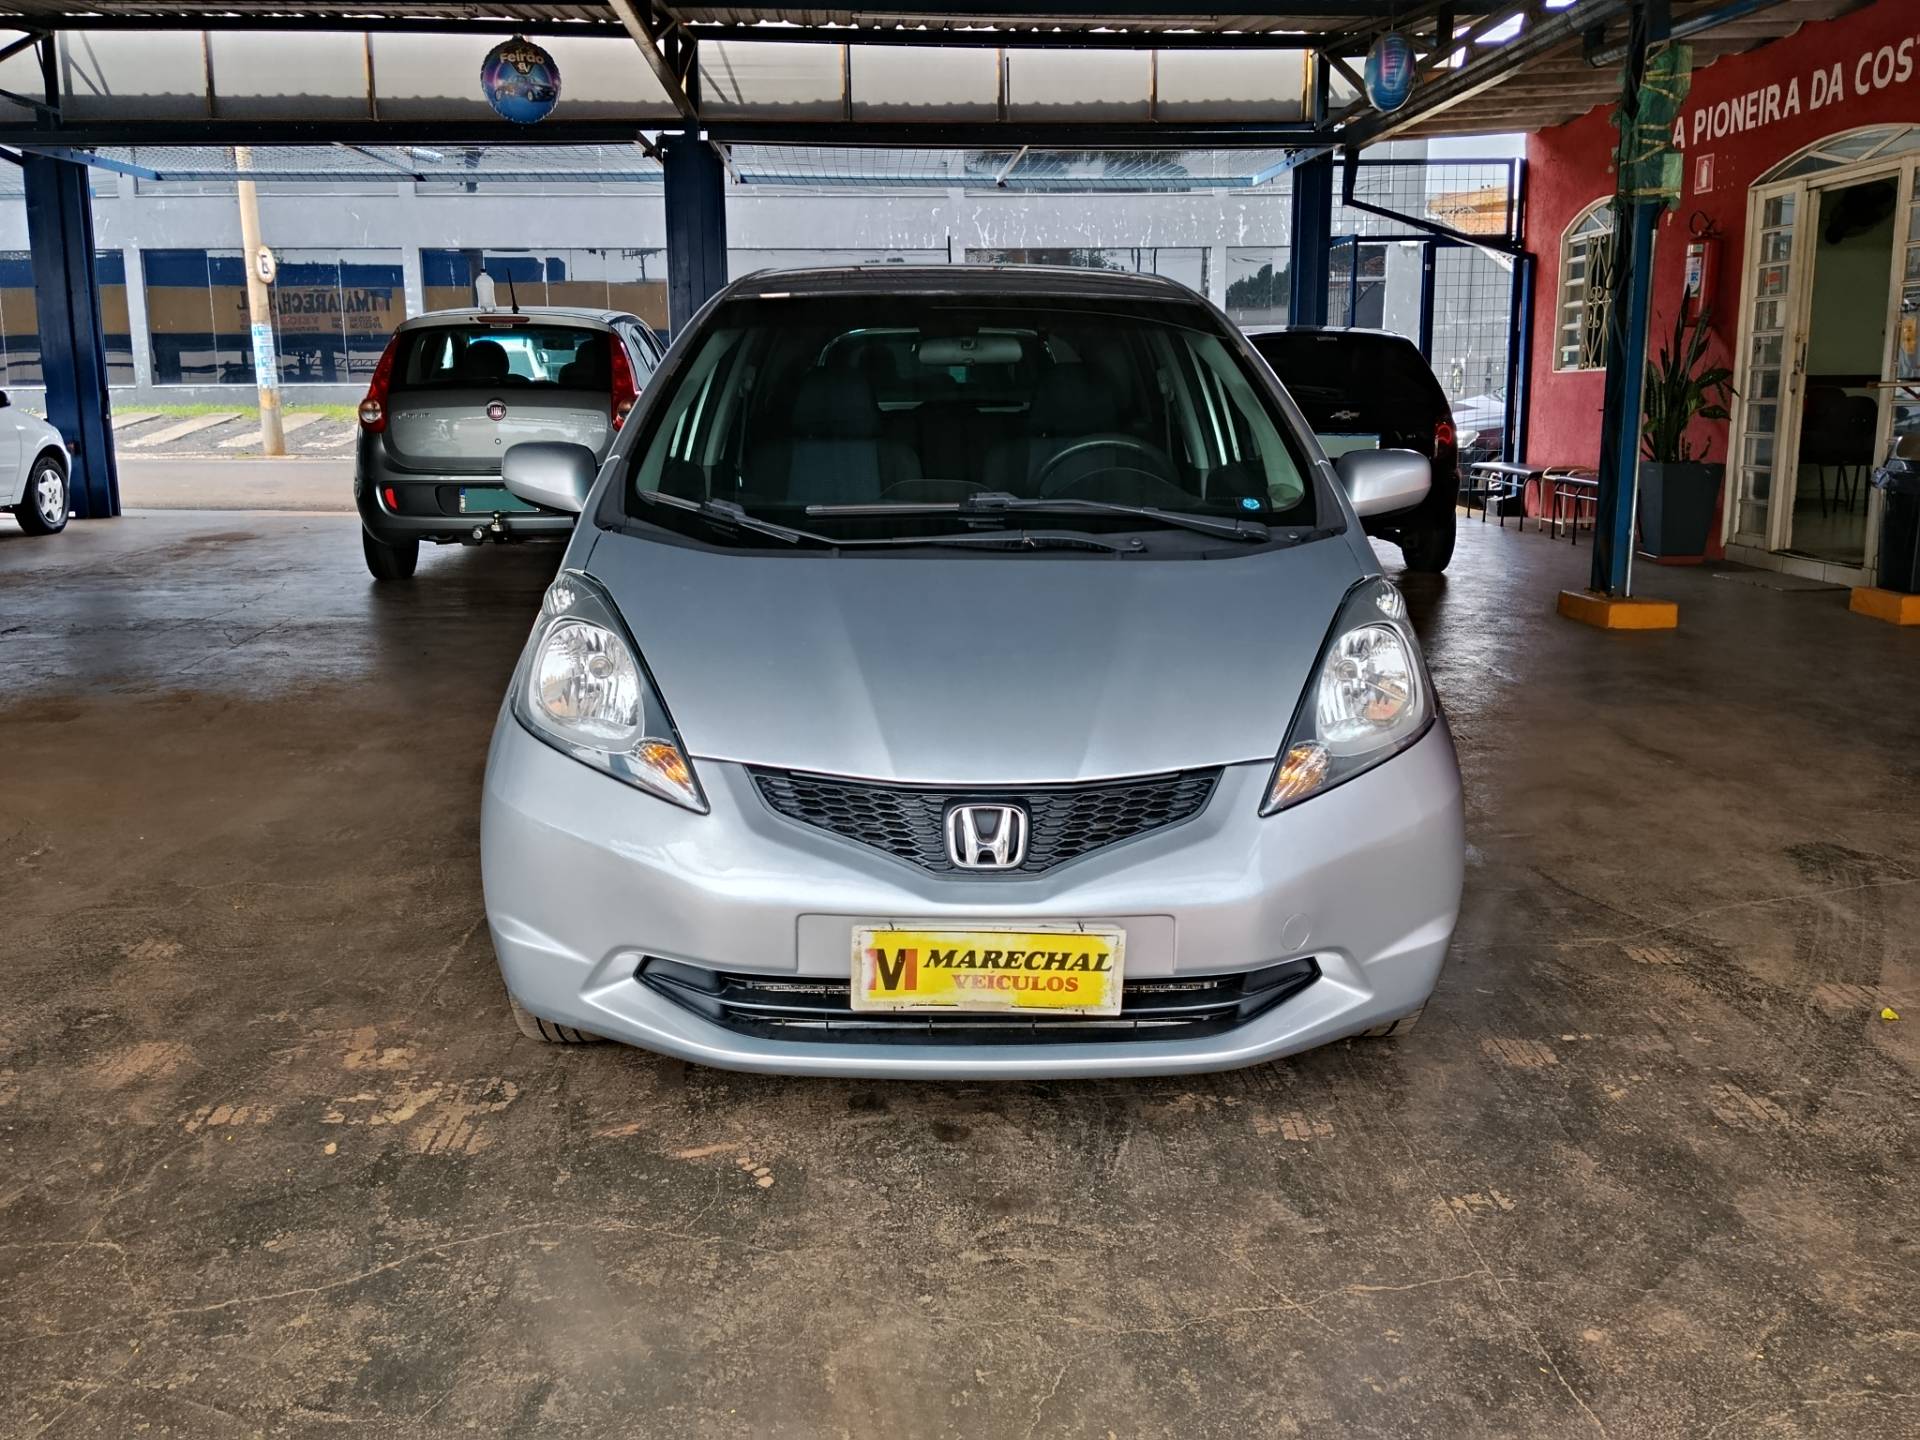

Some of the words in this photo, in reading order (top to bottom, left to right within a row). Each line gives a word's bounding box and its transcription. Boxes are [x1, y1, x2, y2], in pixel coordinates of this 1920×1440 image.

[1672, 116, 1686, 149] A
[1693, 77, 1801, 146] PIONEIRA
[1809, 62, 1844, 111] DA
[1854, 33, 1920, 96] COS
[923, 949, 1113, 972] MARECHAL
[952, 970, 1079, 992] VEÍCULOS
